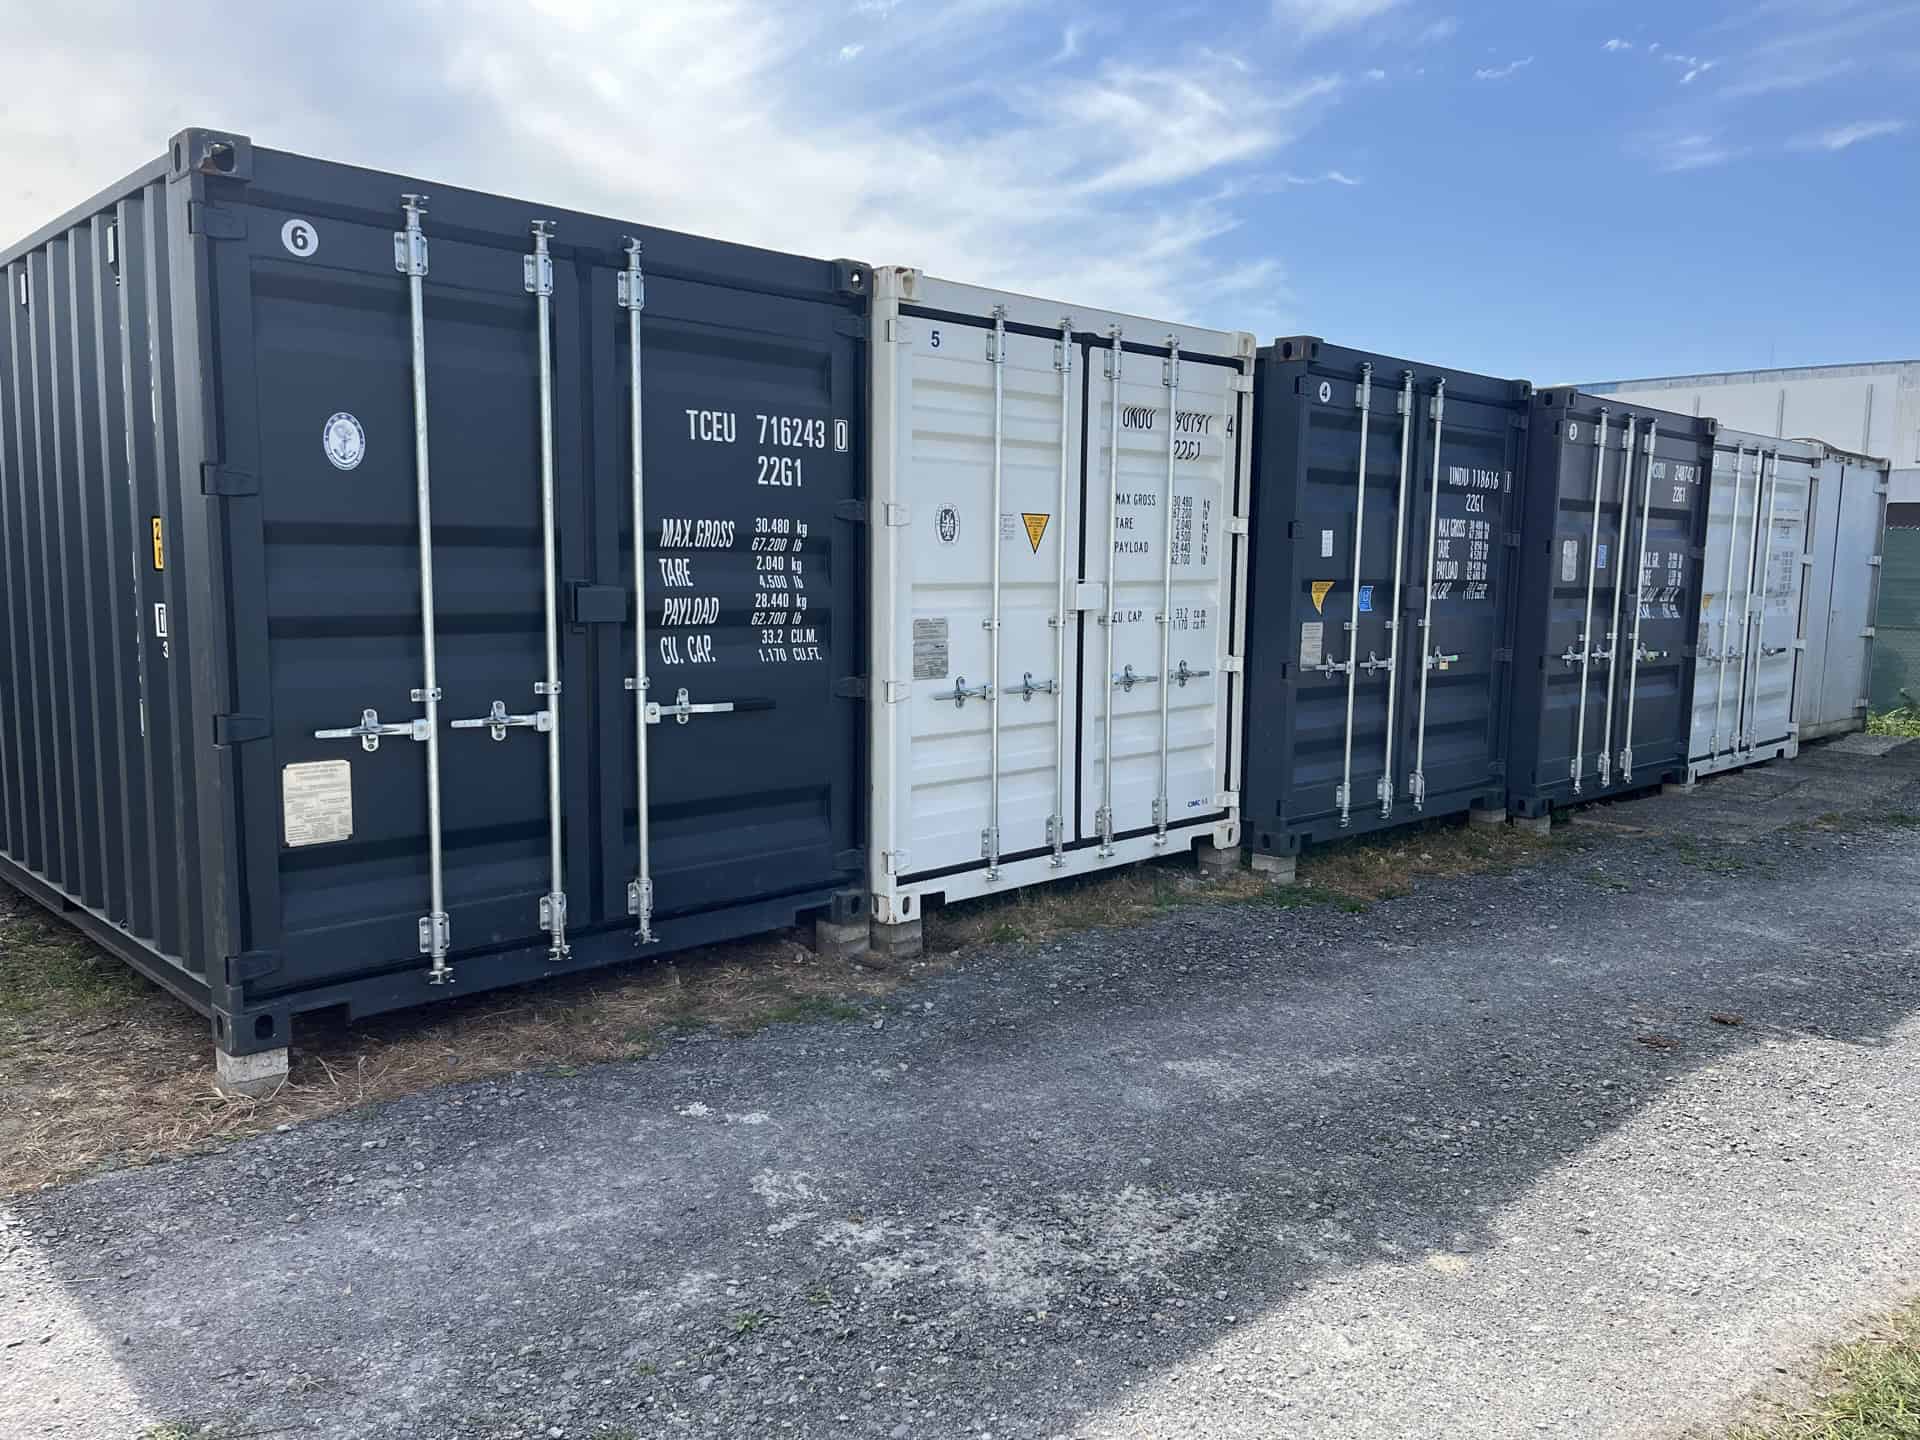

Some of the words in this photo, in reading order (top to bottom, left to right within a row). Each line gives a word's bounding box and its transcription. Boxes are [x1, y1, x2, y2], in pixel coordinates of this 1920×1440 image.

[290, 226, 309, 250] 6
[931, 330, 940, 348] 5
[686, 409, 736, 442] TCEU
[756, 414, 825, 449] 716243
[757, 455, 802, 487] 22G1
[1465, 494, 1484, 512] 22G1
[1114, 517, 1135, 530] TARE
[659, 518, 735, 548] MAX.GROSS
[755, 518, 790, 534] 30.480
[796, 520, 808, 538] kg
[751, 537, 788, 552] 67.200
[792, 538, 803, 552] lb
[1114, 541, 1150, 553] PAYLOAD
[658, 558, 694, 587] TARE
[756, 556, 784, 571] 2.040
[791, 557, 803, 574] kg
[759, 574, 788, 589] 4.500
[793, 575, 804, 589] lb
[661, 597, 720, 626] PAYLOAD
[755, 592, 790, 608] 28.440
[796, 594, 808, 611] kg
[751, 611, 787, 626] 62.700
[792, 612, 803, 626] lb
[761, 629, 783, 644] 33.2
[791, 628, 818, 643] CU.M.
[660, 636, 684, 664] CU.
[687, 635, 716, 663] CAP.
[758, 647, 788, 662] 1.170
[793, 647, 823, 662] CU.FT.
